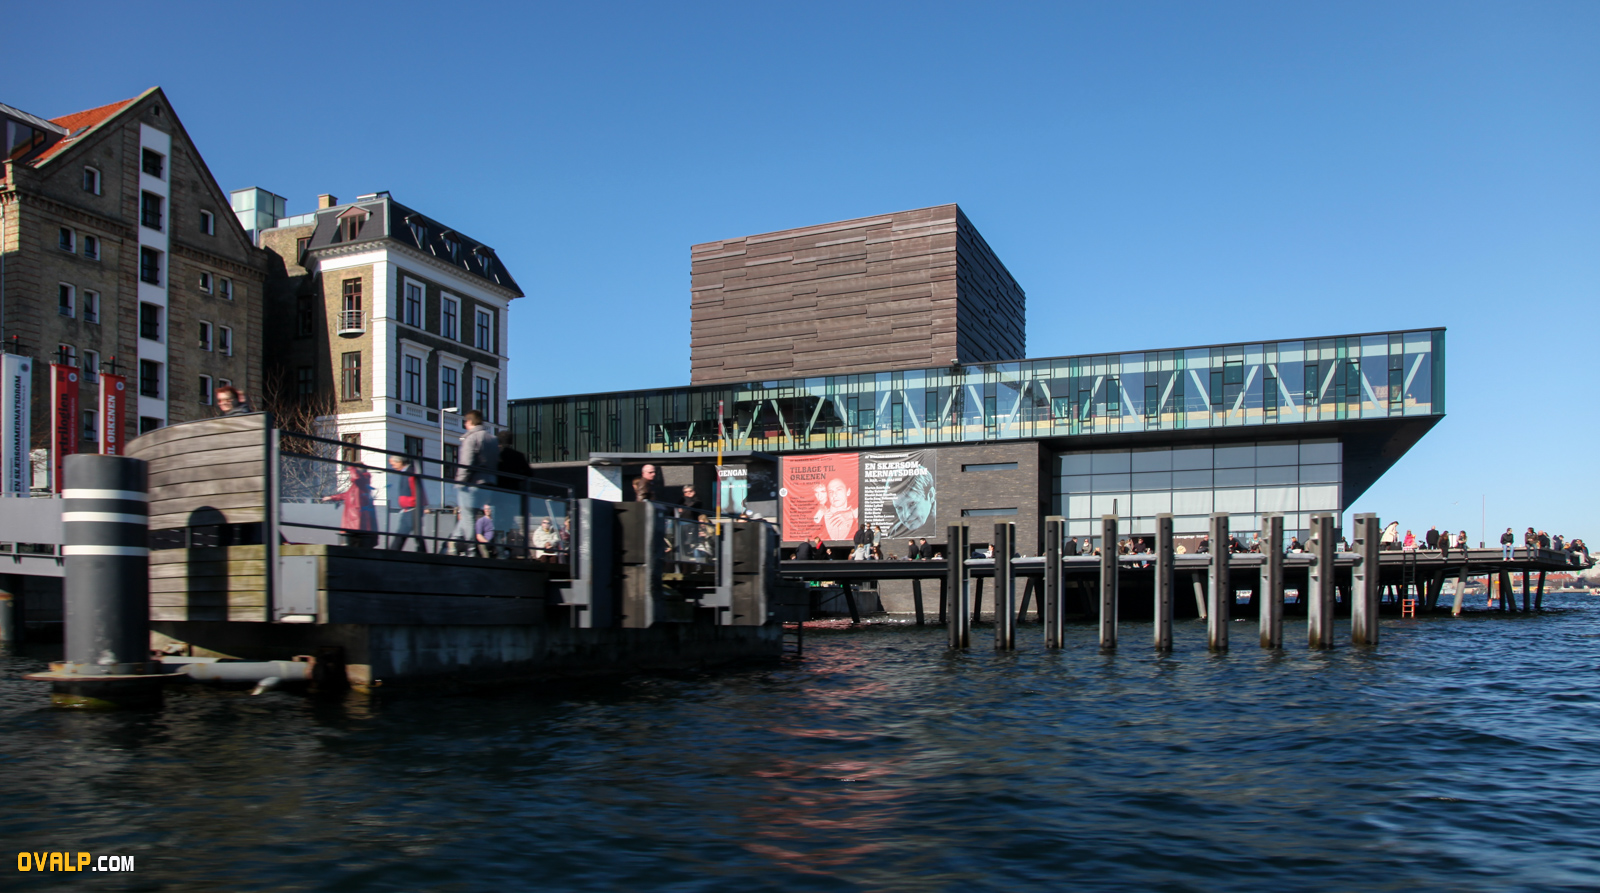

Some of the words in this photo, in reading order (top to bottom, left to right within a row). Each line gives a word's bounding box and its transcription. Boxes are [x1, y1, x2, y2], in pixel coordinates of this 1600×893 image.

[107, 394, 116, 443] ØRKENEN
[790, 465, 822, 474] TILBAGE
[823, 464, 836, 472] TIL
[864, 462, 876, 470] EN
[790, 473, 827, 481] ØRKENEN
[864, 467, 928, 478] MERNATSDRØM
[14, 481, 21, 492] EN
